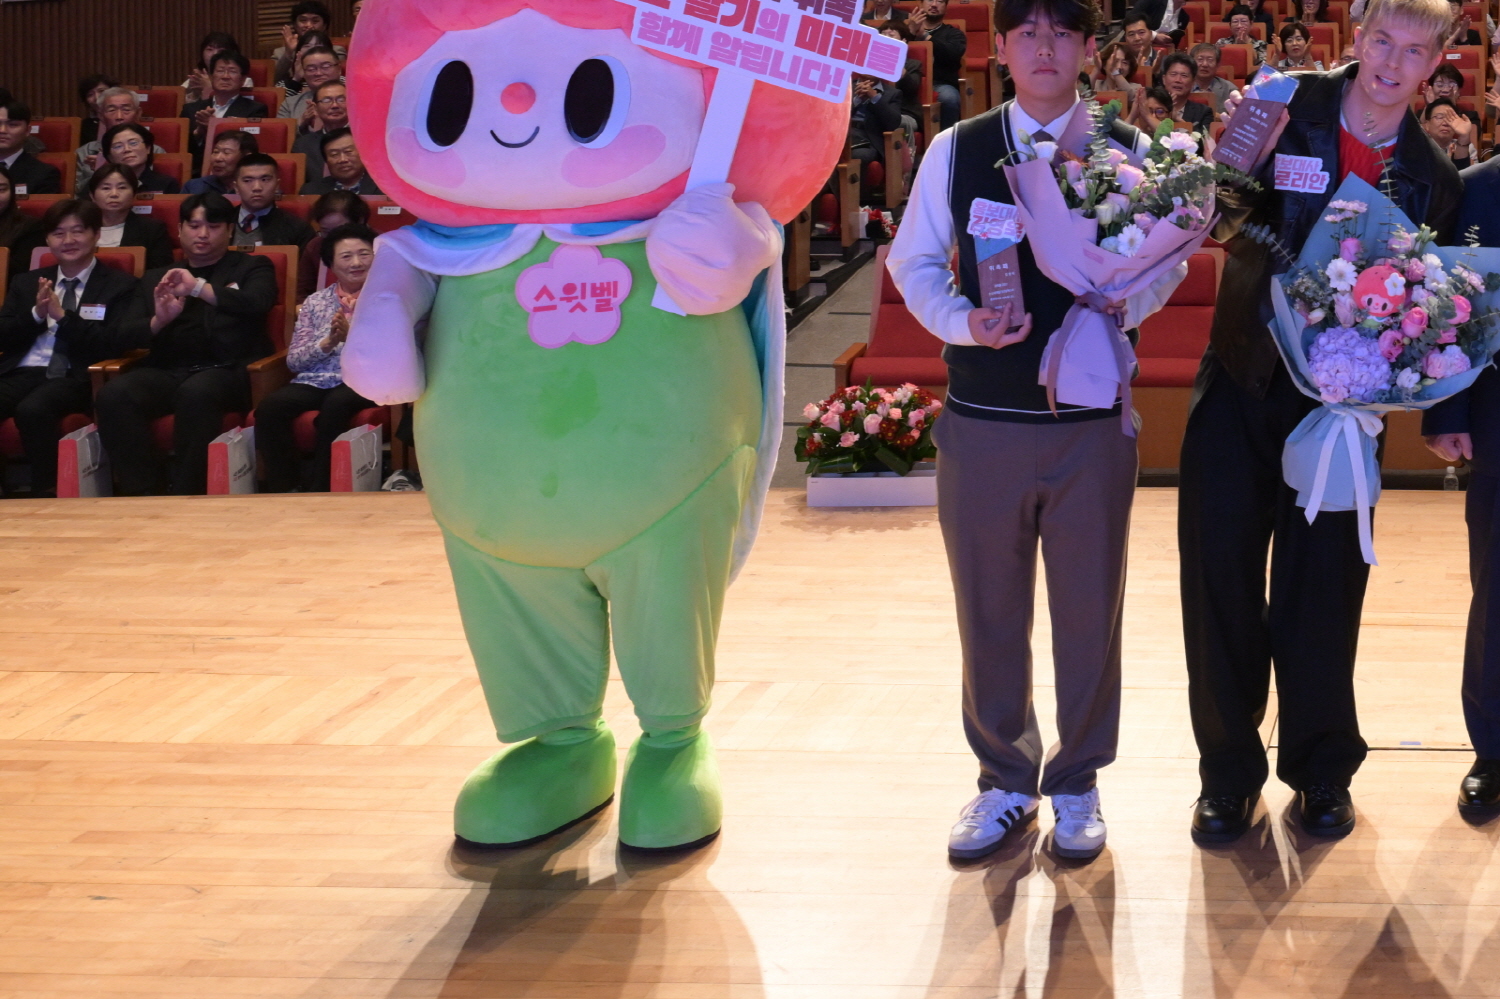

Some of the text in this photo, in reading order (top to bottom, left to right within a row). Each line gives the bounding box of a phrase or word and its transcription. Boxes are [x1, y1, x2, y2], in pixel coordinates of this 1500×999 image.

[637, 11, 847, 97] 함께 알립니다!
[795, 15, 901, 75] 미래를
[532, 281, 618, 313] 스윗벨
